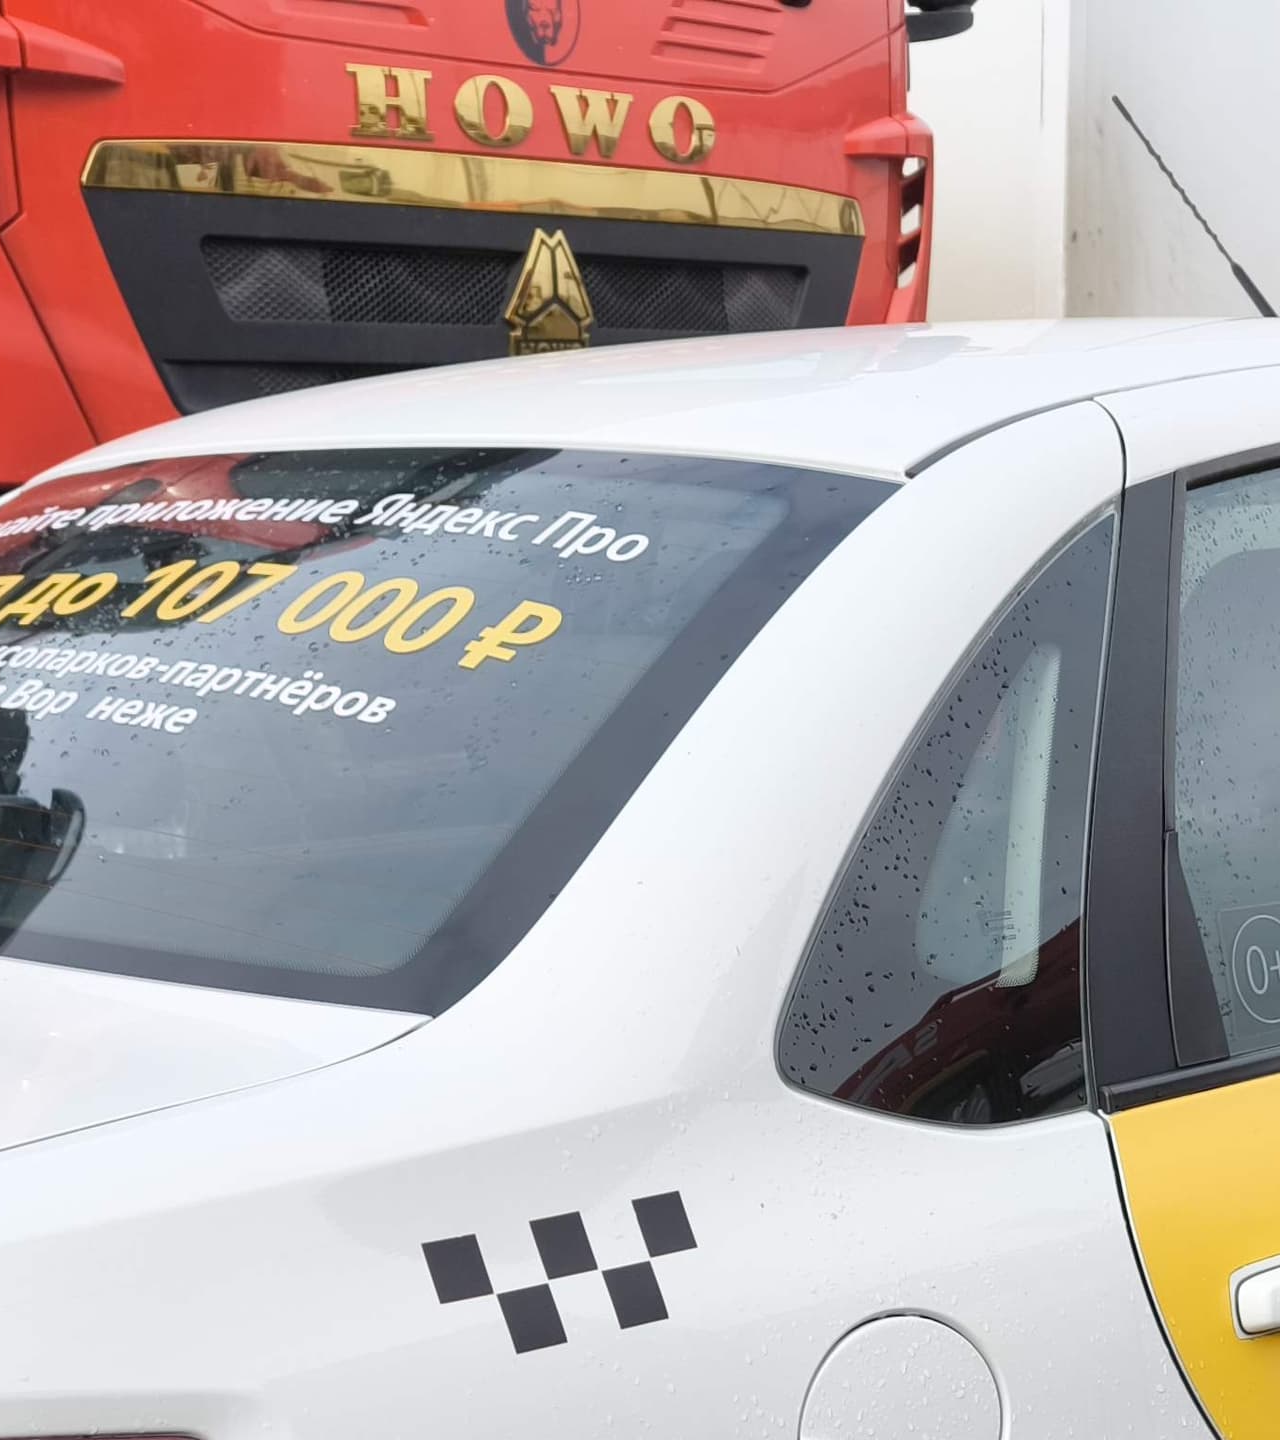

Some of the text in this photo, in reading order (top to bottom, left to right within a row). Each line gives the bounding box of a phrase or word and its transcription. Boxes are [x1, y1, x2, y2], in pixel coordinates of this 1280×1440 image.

[345, 62, 716, 164] HOWO
[77, 497, 359, 532] приложение
[353, 493, 541, 542] Яндекс
[531, 510, 650, 562] Про
[120, 559, 298, 624] 107
[277, 570, 475, 654] 000
